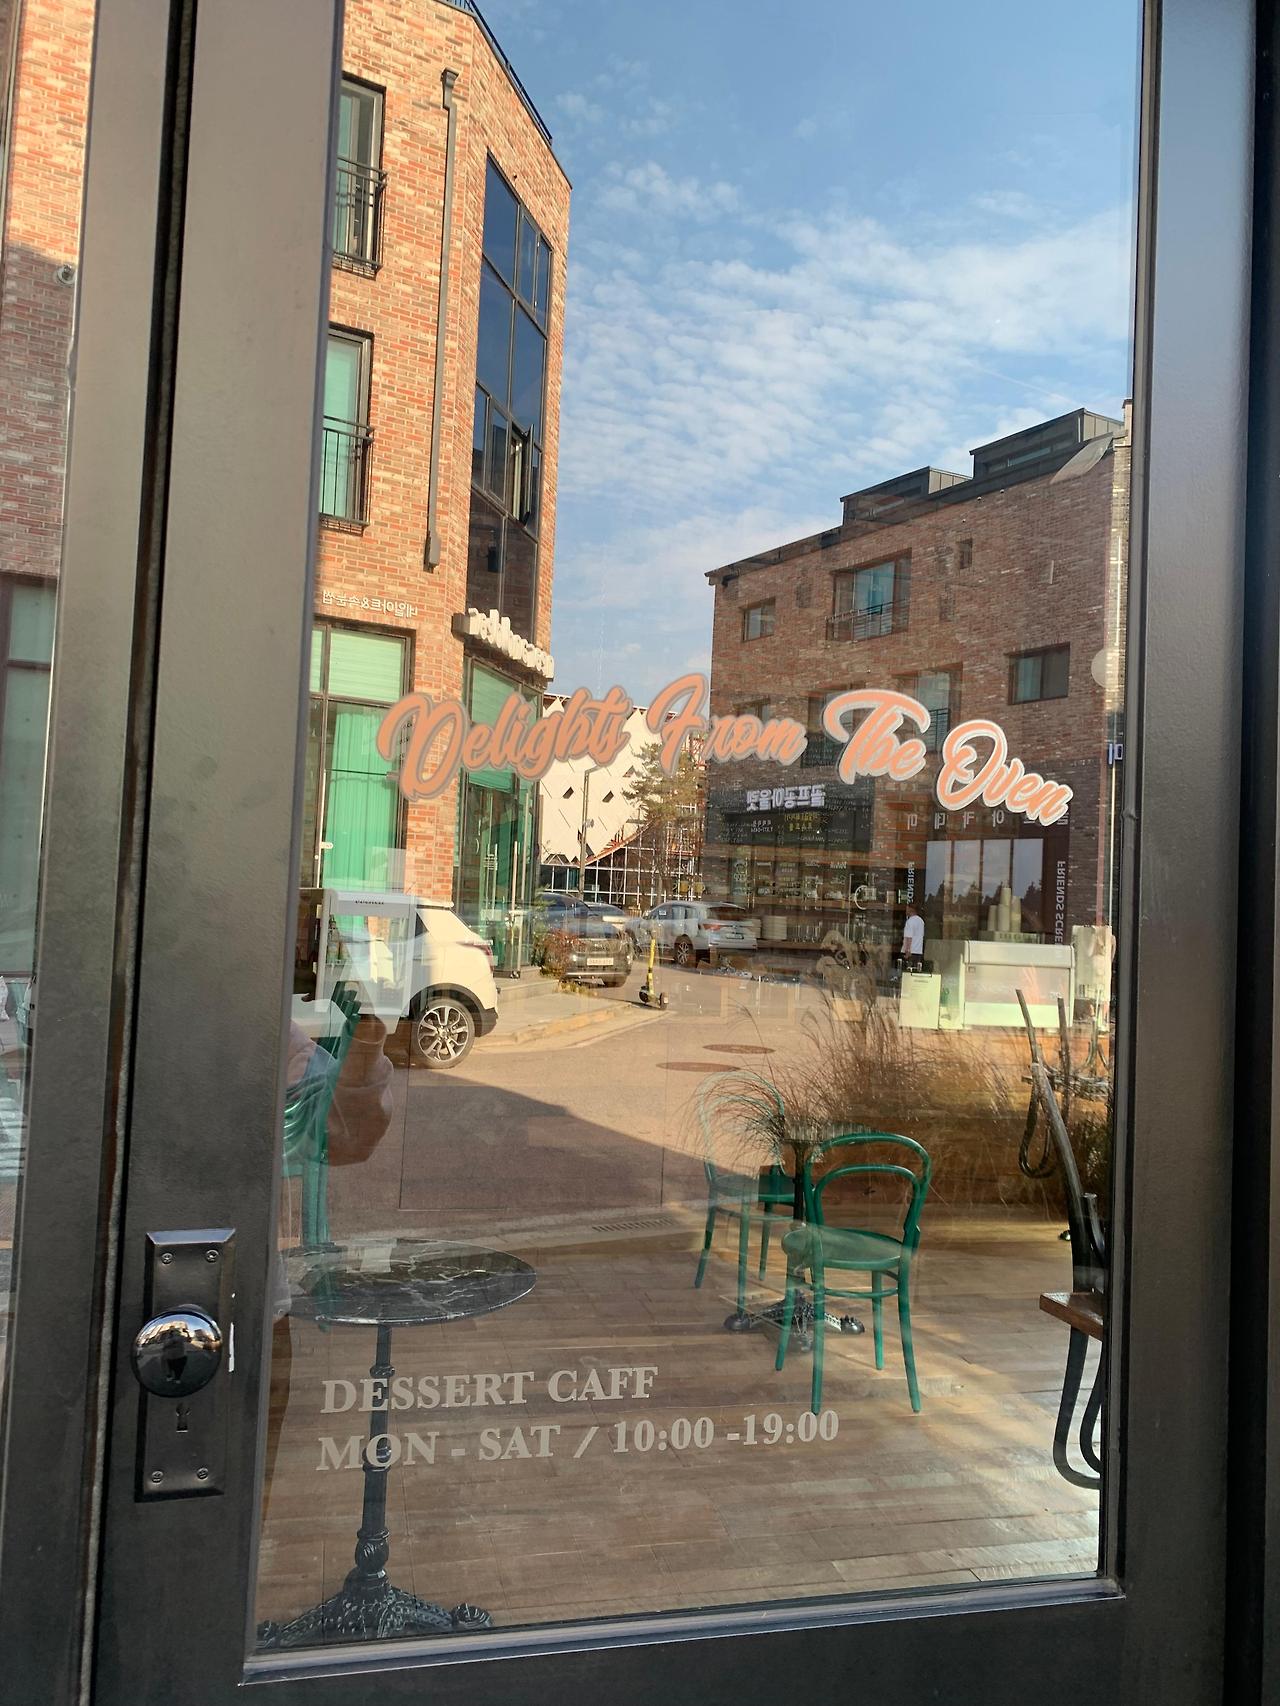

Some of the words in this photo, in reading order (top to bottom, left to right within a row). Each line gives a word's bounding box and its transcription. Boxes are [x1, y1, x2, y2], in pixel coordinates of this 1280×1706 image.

[376, 684, 633, 801] Delights
[647, 673, 807, 777] From
[822, 688, 931, 786] The
[936, 718, 1074, 827] Oven
[320, 1371, 535, 1414] DESSERT
[316, 1430, 440, 1471] MON
[478, 1424, 560, 1461] SAT
[613, 1416, 715, 1453] 10:00
